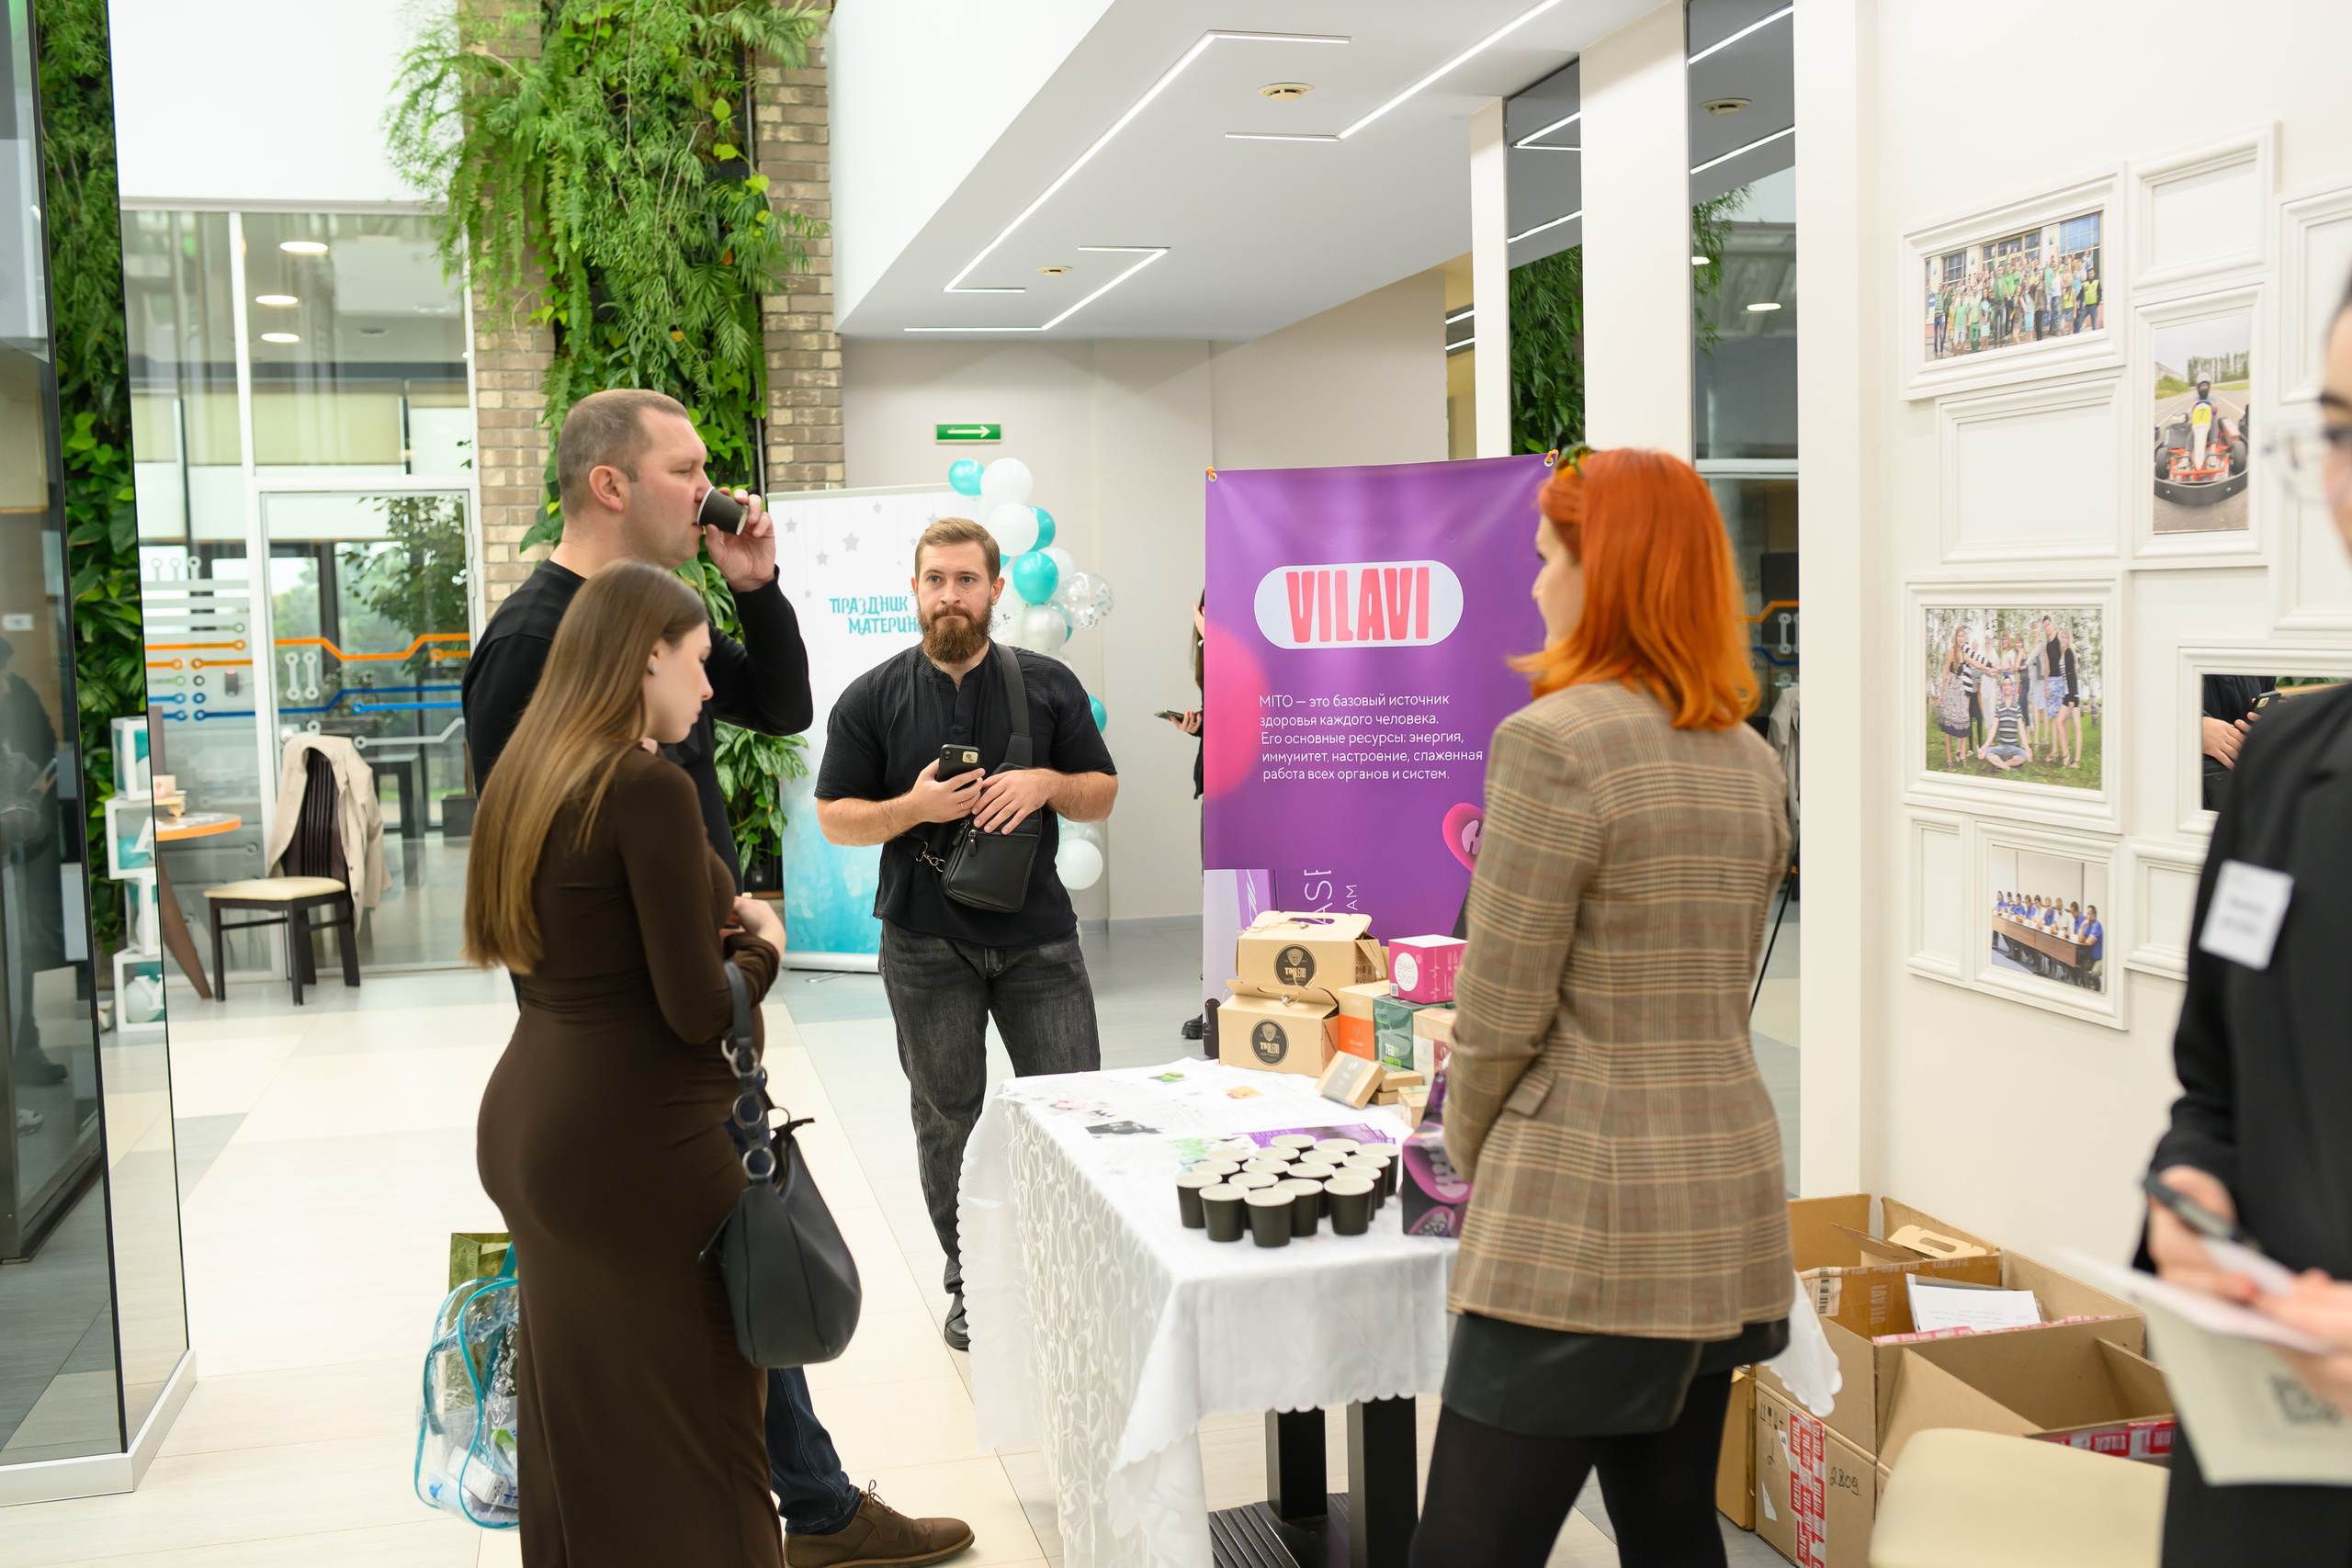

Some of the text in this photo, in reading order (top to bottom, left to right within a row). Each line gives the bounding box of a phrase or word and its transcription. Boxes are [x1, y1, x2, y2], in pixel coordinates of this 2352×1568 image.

[829, 595, 908, 615] ПРАЗДНИК
[1285, 566, 1430, 643] VILAVI
[1309, 697, 1329, 707] это
[1333, 694, 1385, 706] базовый
[1389, 694, 1450, 705] источник
[1260, 714, 1439, 728] здоровья каждого человека.
[1261, 732, 1464, 746] Его основные ресурсы: энергия,
[1332, 751, 1410, 764] настроение,
[1413, 750, 1483, 761] слаженная
[1263, 768, 1450, 782] работа всех органов и систем.
[1397, 959, 1416, 973] Beet
[1397, 972, 1416, 986] Shot
